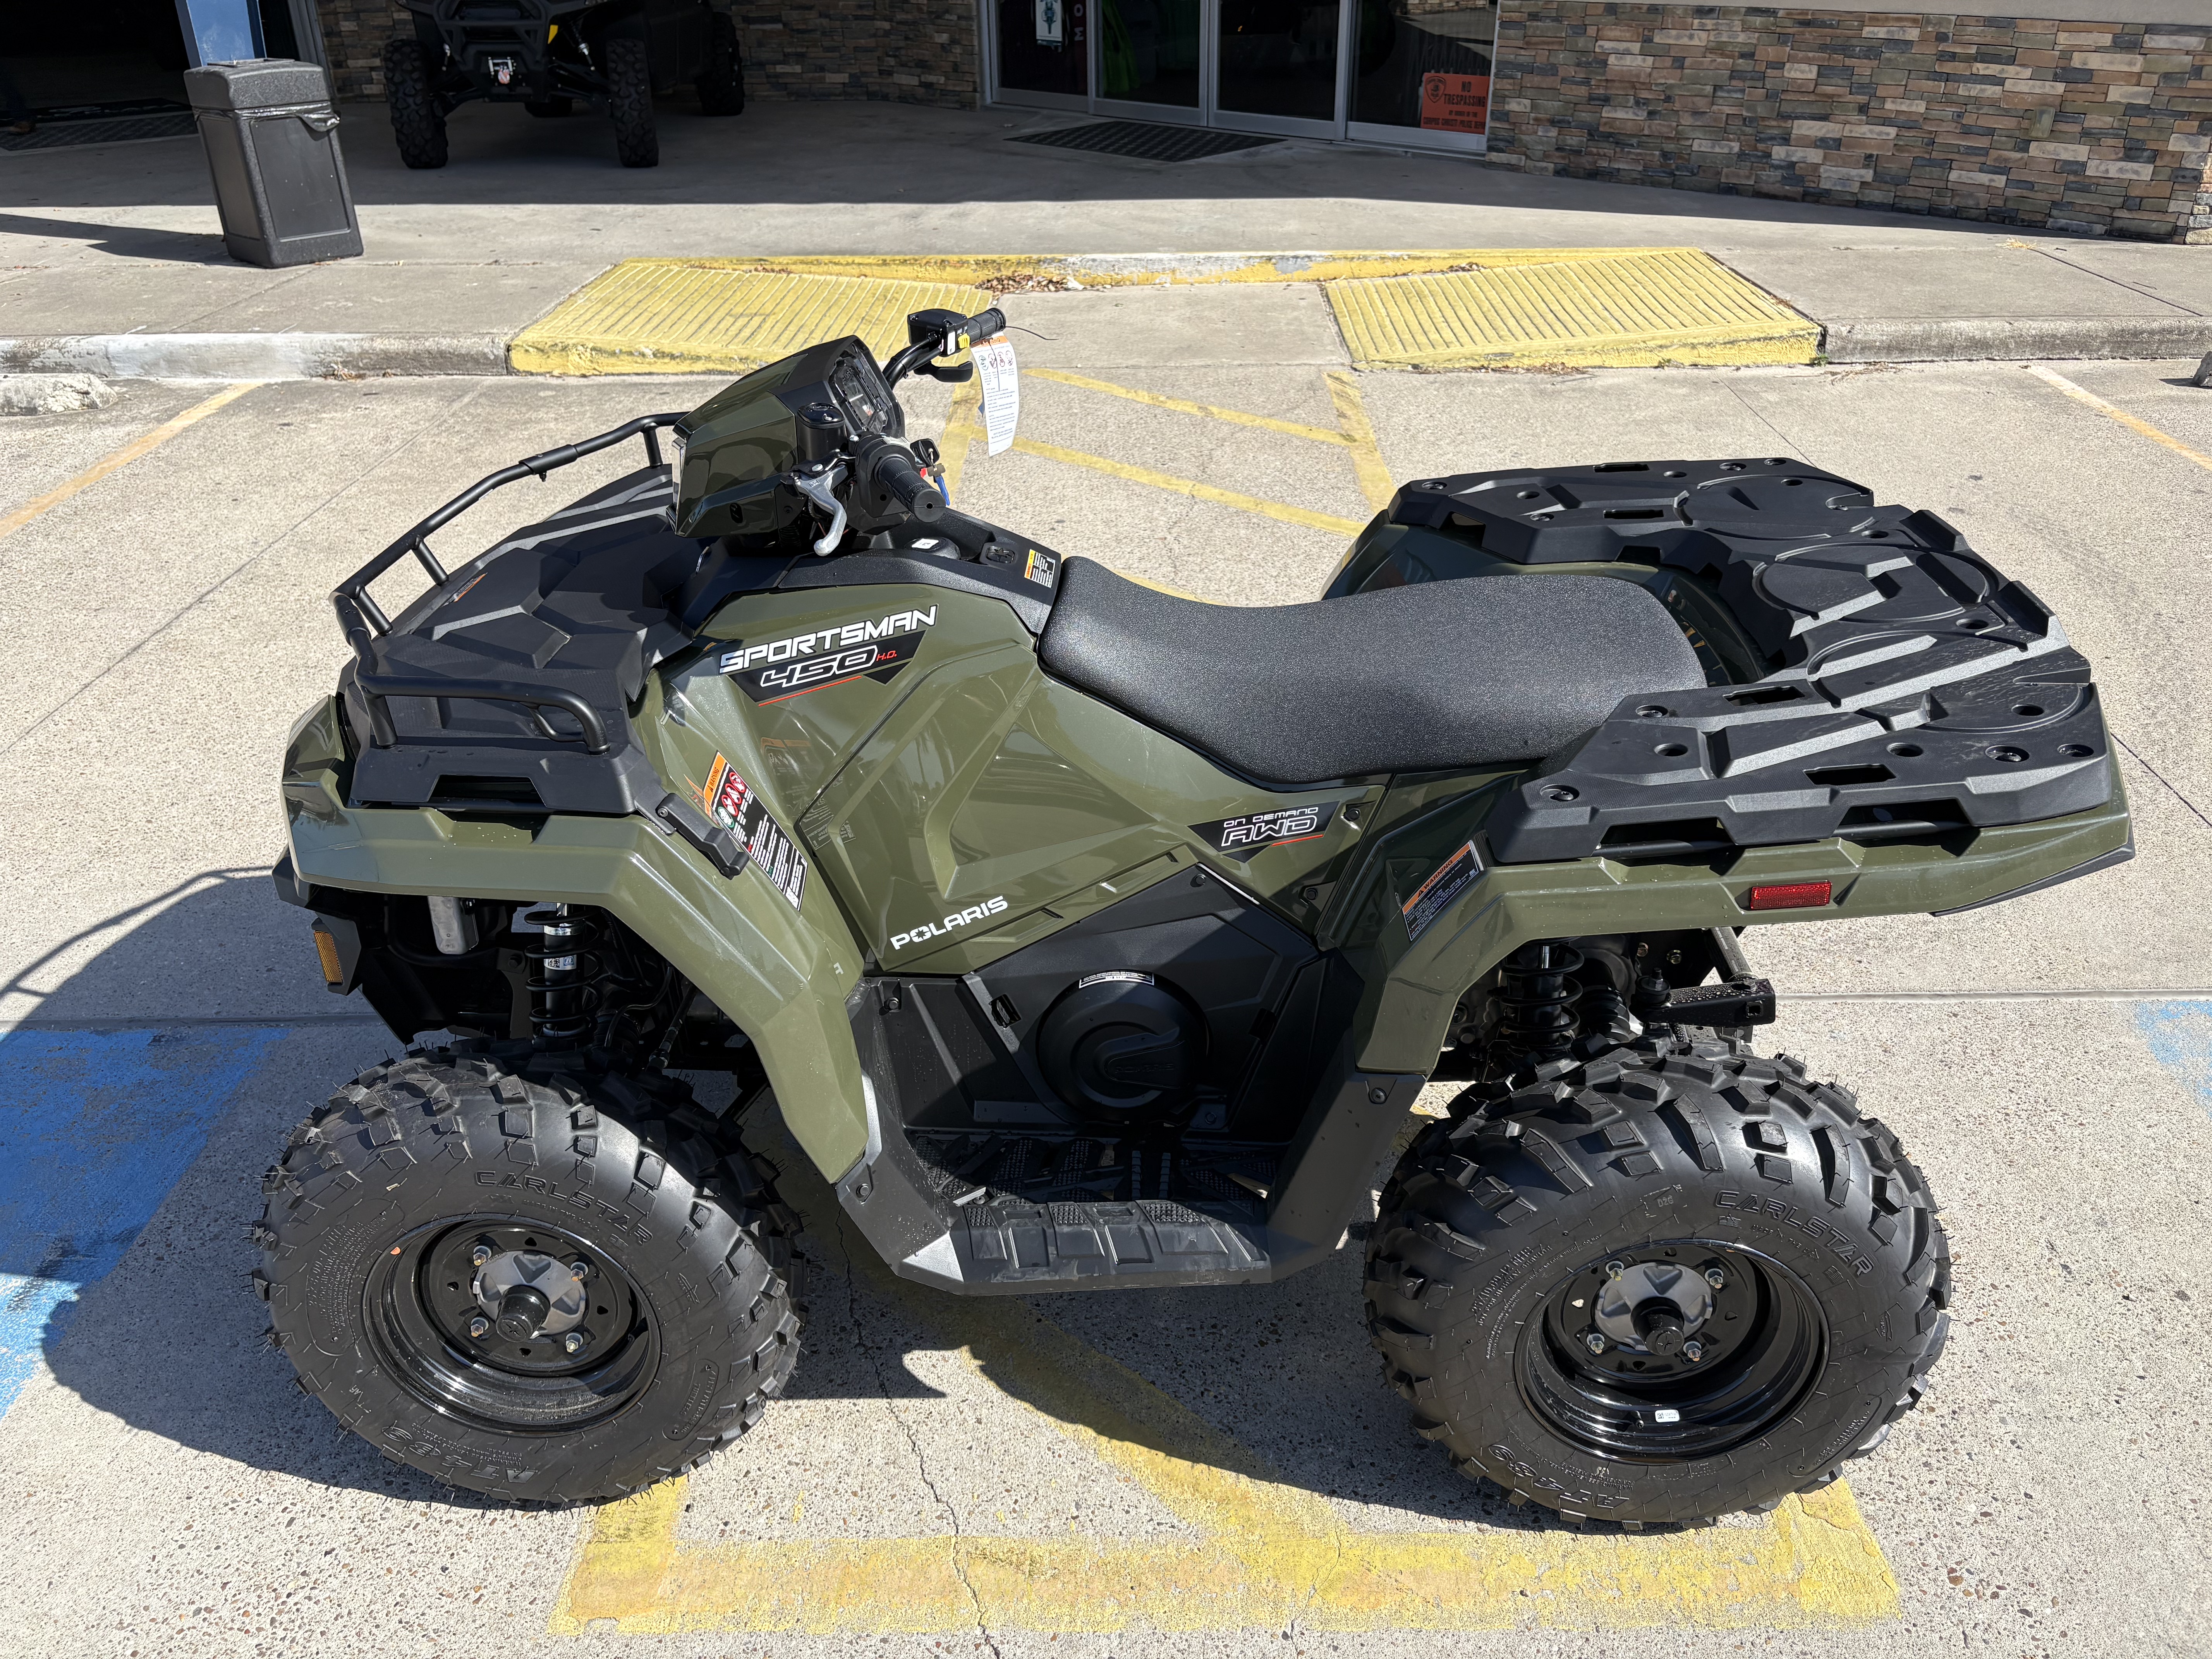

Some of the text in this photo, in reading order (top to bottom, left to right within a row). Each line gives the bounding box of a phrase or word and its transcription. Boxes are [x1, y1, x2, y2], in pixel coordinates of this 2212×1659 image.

[1444, 94, 1486, 107] TRESPASSING
[1462, 81, 1472, 92] NO
[720, 605, 938, 674] SPORTSMAN
[761, 645, 878, 688] 450
[1221, 815, 1317, 847] AWD
[1223, 807, 1318, 828] ON DEMAND
[1423, 859, 1453, 889] WARNING
[890, 895, 1008, 950] POLARIS
[475, 1170, 653, 1246] CARLSTAR
[1715, 1190, 1874, 1275] CARLSTAR
